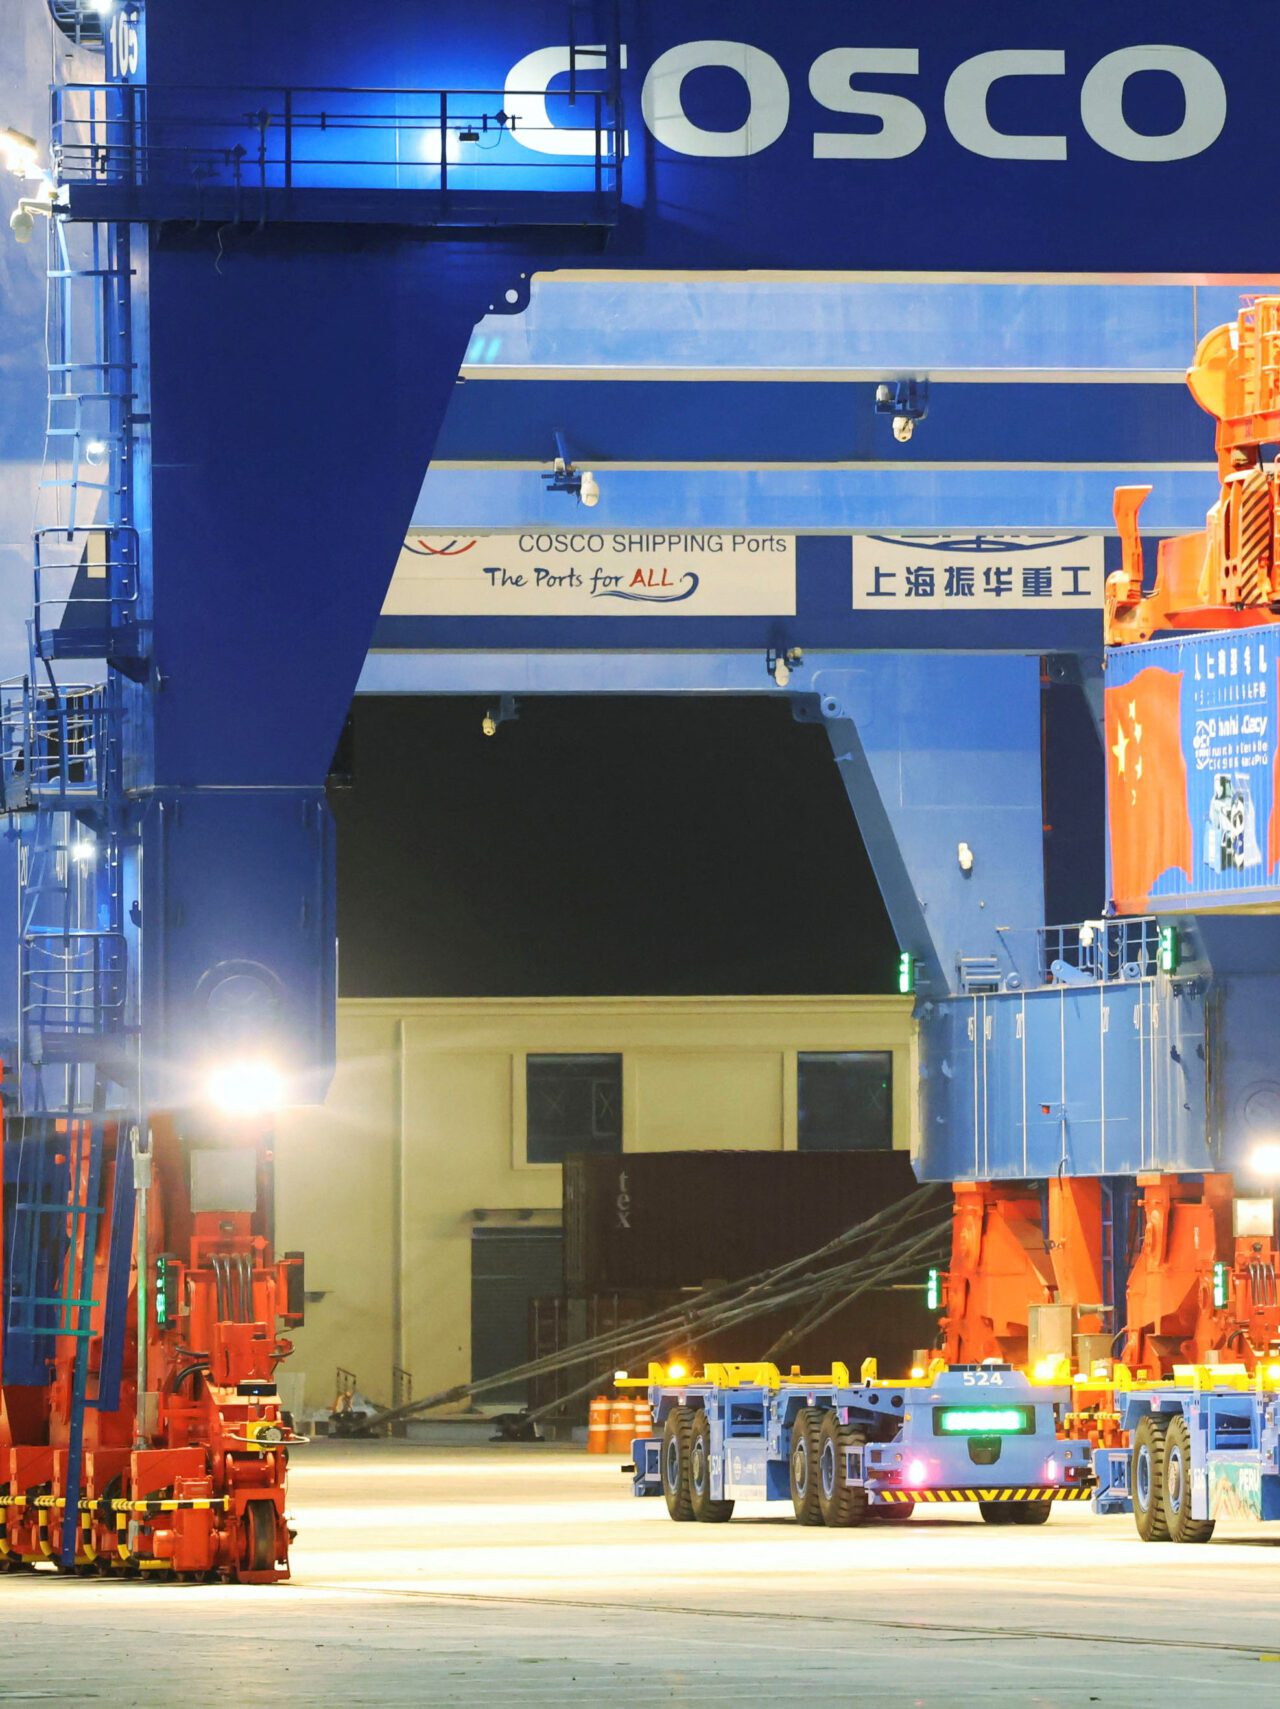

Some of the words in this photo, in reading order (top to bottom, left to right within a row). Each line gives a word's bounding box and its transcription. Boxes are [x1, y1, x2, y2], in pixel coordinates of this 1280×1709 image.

[503, 40, 1227, 162] COSCO
[518, 534, 604, 552] COSCO
[613, 534, 723, 552] SHIPPING
[733, 534, 787, 552] Ports
[483, 567, 528, 587] The
[534, 567, 583, 587] Ports
[590, 567, 624, 594] for
[629, 568, 674, 587] ALL
[866, 566, 1091, 597] 上海振华重工
[616, 1171, 631, 1228] tex
[963, 1372, 1003, 1386] 524
